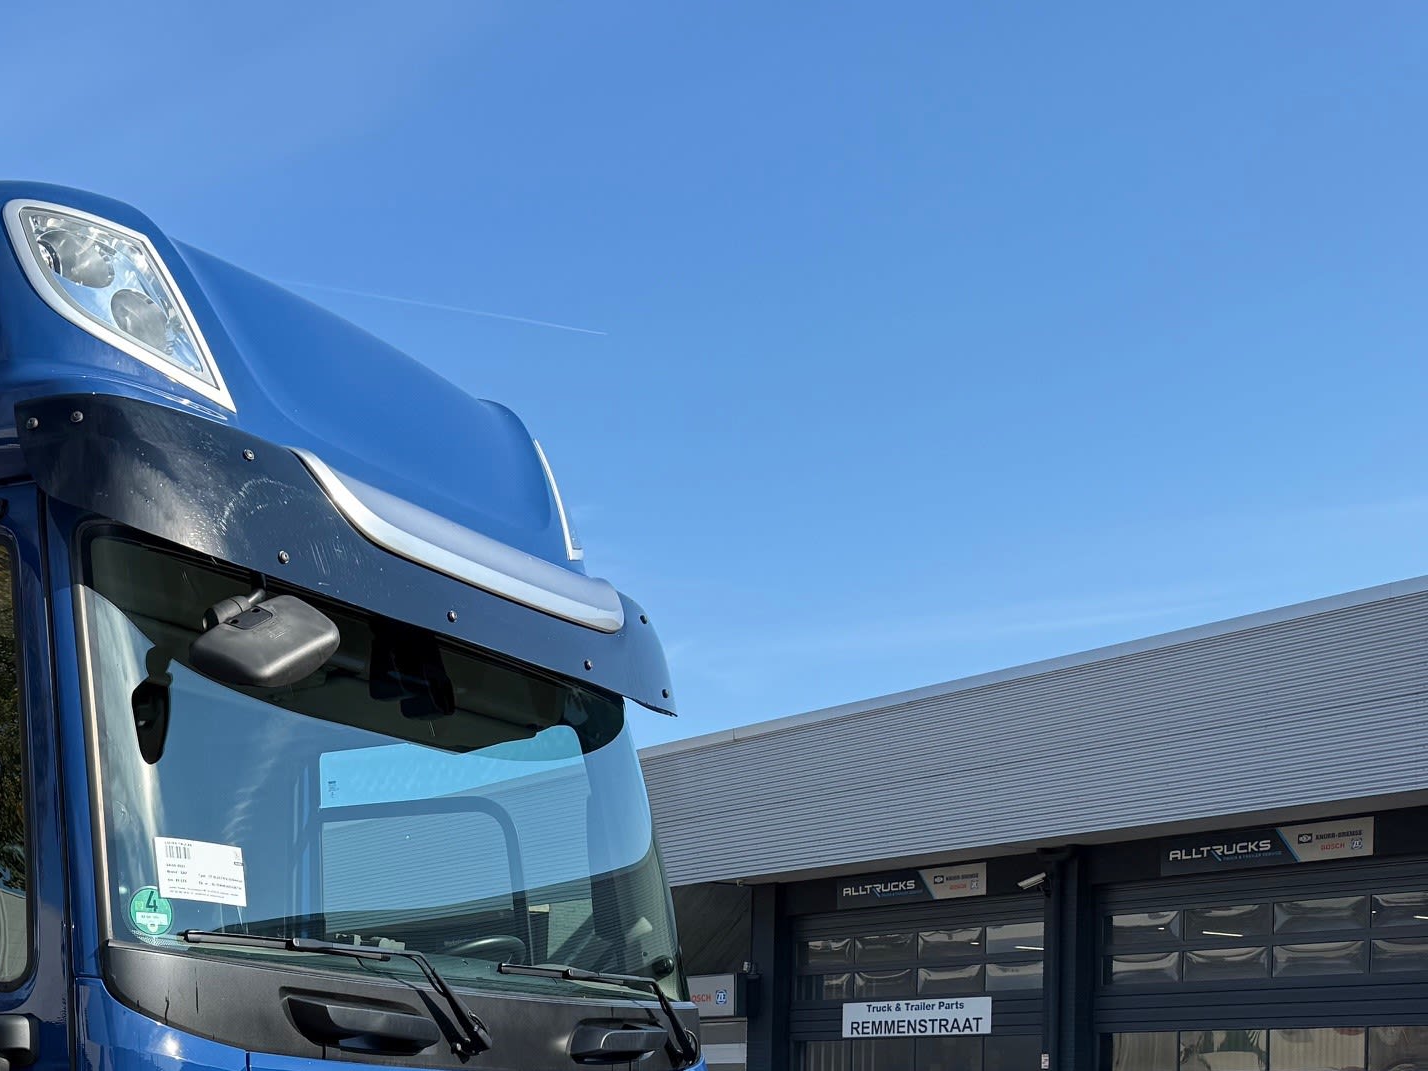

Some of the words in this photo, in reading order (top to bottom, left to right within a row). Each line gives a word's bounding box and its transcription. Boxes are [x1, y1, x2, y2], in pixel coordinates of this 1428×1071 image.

[1169, 839, 1272, 862] ALLTRUCKS
[843, 880, 916, 897] ALLTRUCKS
[146, 891, 158, 912] 4
[866, 1003, 892, 1013] Truck
[894, 1003, 902, 1012] &
[905, 1002, 936, 1011] Trailer
[938, 1000, 965, 1010] Parts
[850, 1017, 983, 1035] REMMENSTRAAT
